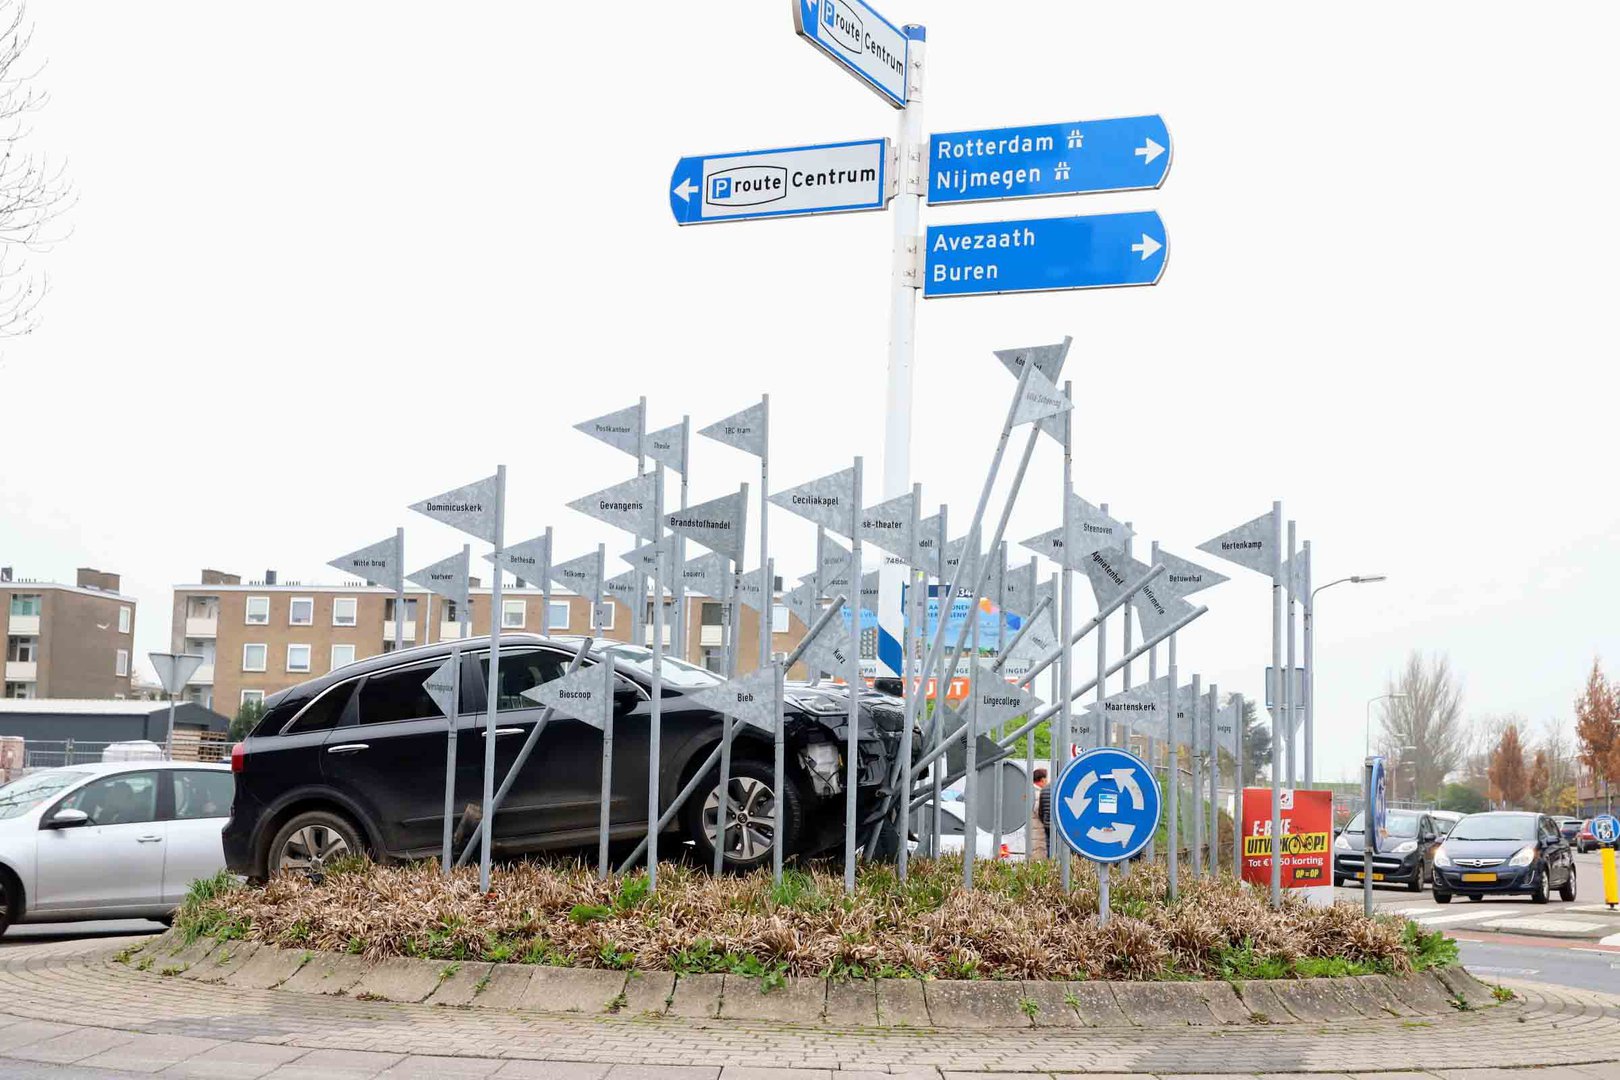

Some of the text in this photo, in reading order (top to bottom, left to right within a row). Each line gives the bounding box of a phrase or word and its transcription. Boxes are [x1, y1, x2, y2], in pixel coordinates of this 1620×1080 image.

[836, 13, 860, 41] route
[864, 33, 904, 76] Centrum
[938, 135, 1054, 159] Rotterdam
[735, 175, 782, 193] route
[792, 168, 876, 188] Centrum
[937, 168, 1041, 193] Nijmegen
[933, 228, 1036, 252] Avezaath
[933, 264, 998, 282] Buren
[595, 424, 631, 433] Postkantoor
[426, 502, 483, 512] Dominicuskerk
[600, 501, 643, 512] Gevangenis
[792, 496, 839, 507] Ceciliakapel
[670, 517, 731, 530] Brandstofhandel
[1083, 523, 1113, 535] Steenoven
[1221, 541, 1263, 550] Hertenkamp
[353, 559, 386, 568] Witte brug
[510, 555, 536, 565] Bethesda
[1091, 551, 1125, 586] Agnietenhof
[1169, 574, 1202, 583] Betuwehal
[1142, 585, 1166, 616] Infirmerie
[833, 648, 846, 664] Kurz
[559, 689, 591, 700] Bioscoop
[737, 693, 754, 702] Bieb
[983, 695, 1021, 706] Lingecollege
[1105, 702, 1156, 711] Maartenskerk
[1248, 859, 1261, 867] Tot
[1292, 856, 1323, 867] korting
[1295, 869, 1304, 878] OP
[1310, 869, 1319, 878] OP
